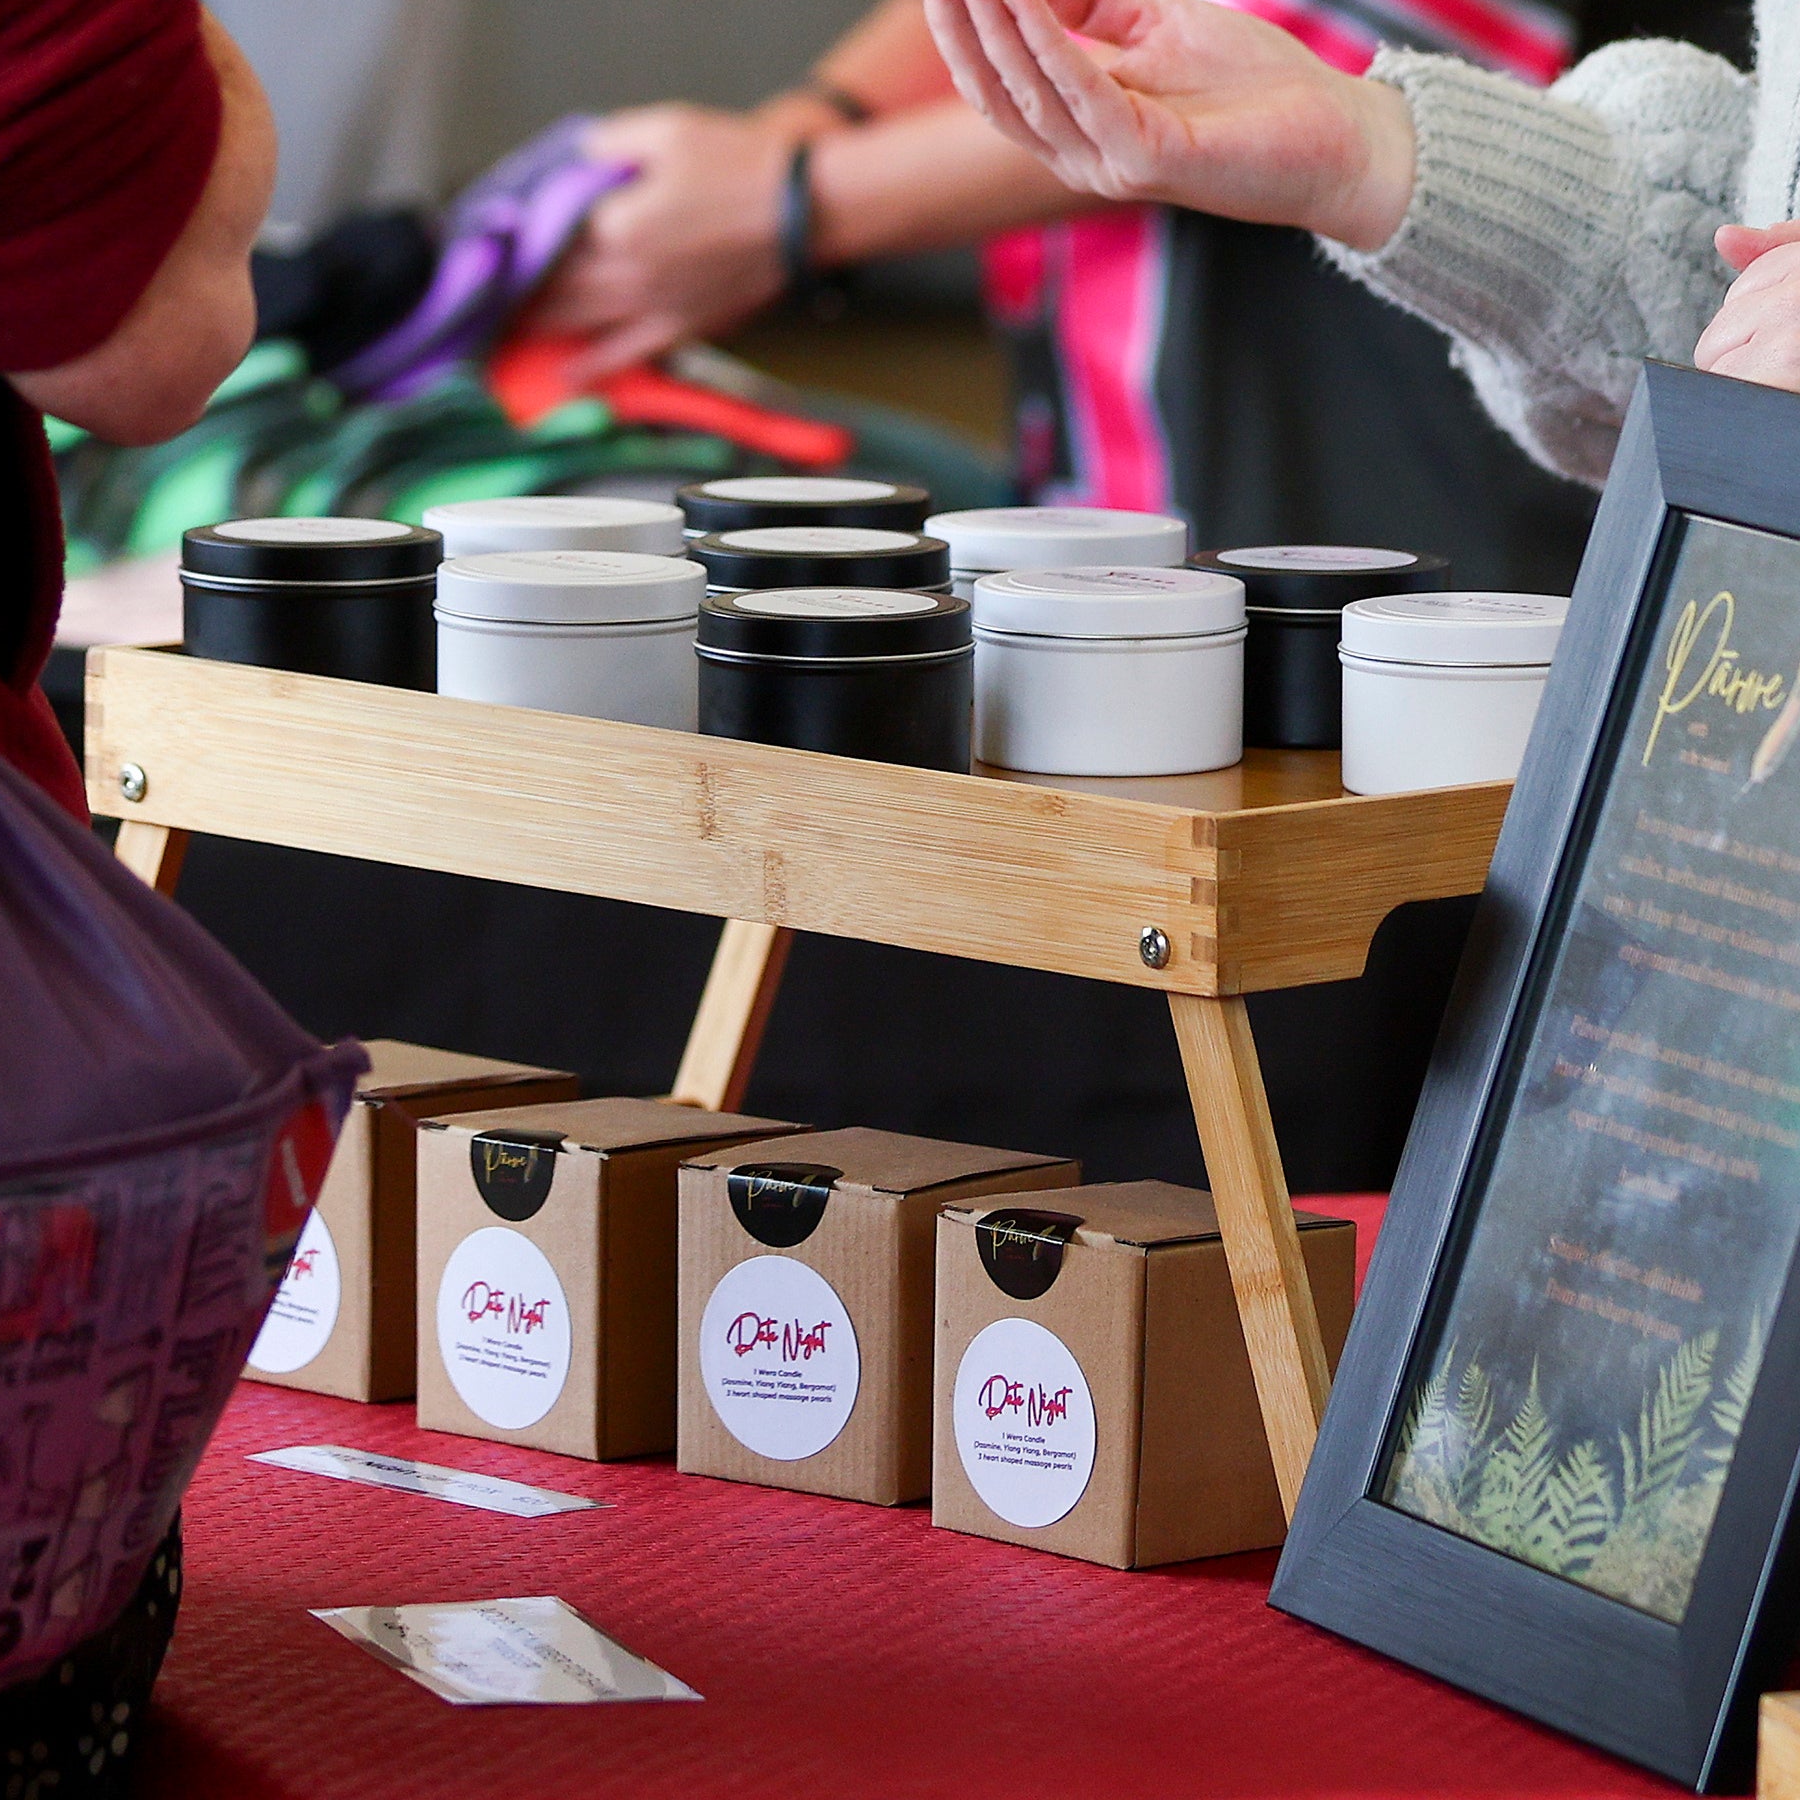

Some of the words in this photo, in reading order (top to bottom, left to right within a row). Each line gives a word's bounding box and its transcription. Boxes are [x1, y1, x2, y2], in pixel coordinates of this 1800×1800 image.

[727, 1312, 778, 1357] Date
[783, 1319, 832, 1362] Night
[978, 1374, 1024, 1421] Date
[1028, 1383, 1073, 1427] Night
[1024, 1435, 1046, 1444] Candle
[983, 1454, 999, 1462] heart
[1000, 1456, 1023, 1465] shaped
[1024, 1458, 1051, 1469] massage
